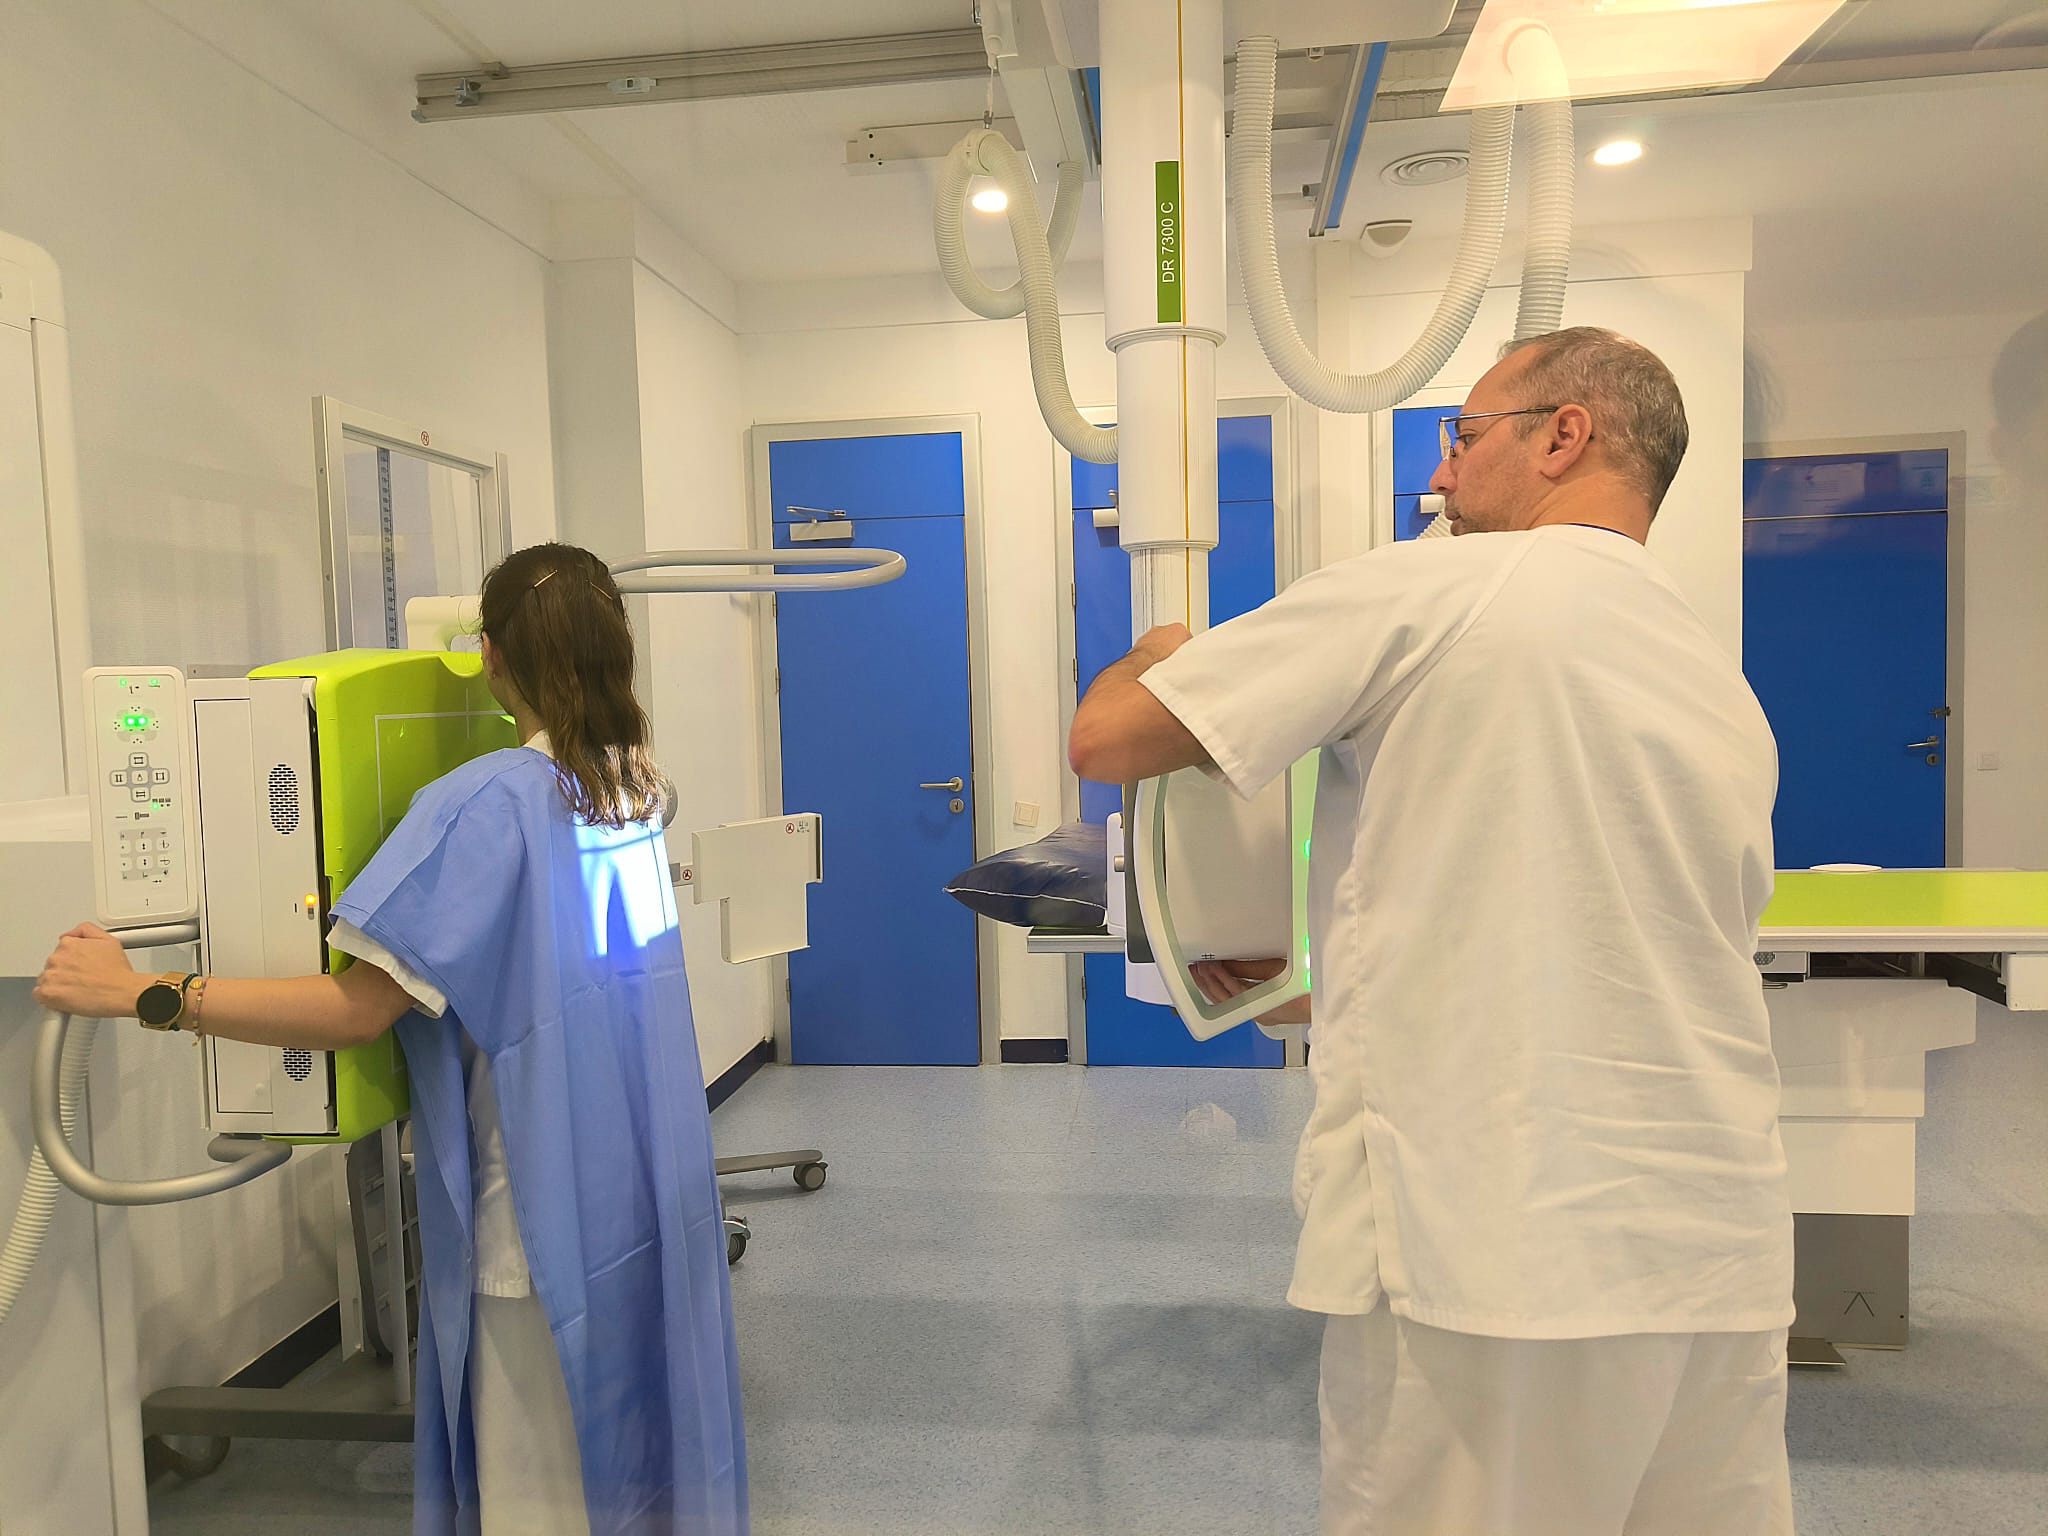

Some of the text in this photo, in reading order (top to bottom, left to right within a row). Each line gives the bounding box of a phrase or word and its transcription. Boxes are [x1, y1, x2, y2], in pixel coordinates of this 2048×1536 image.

[1160, 201, 1175, 283] DR 7300 C
